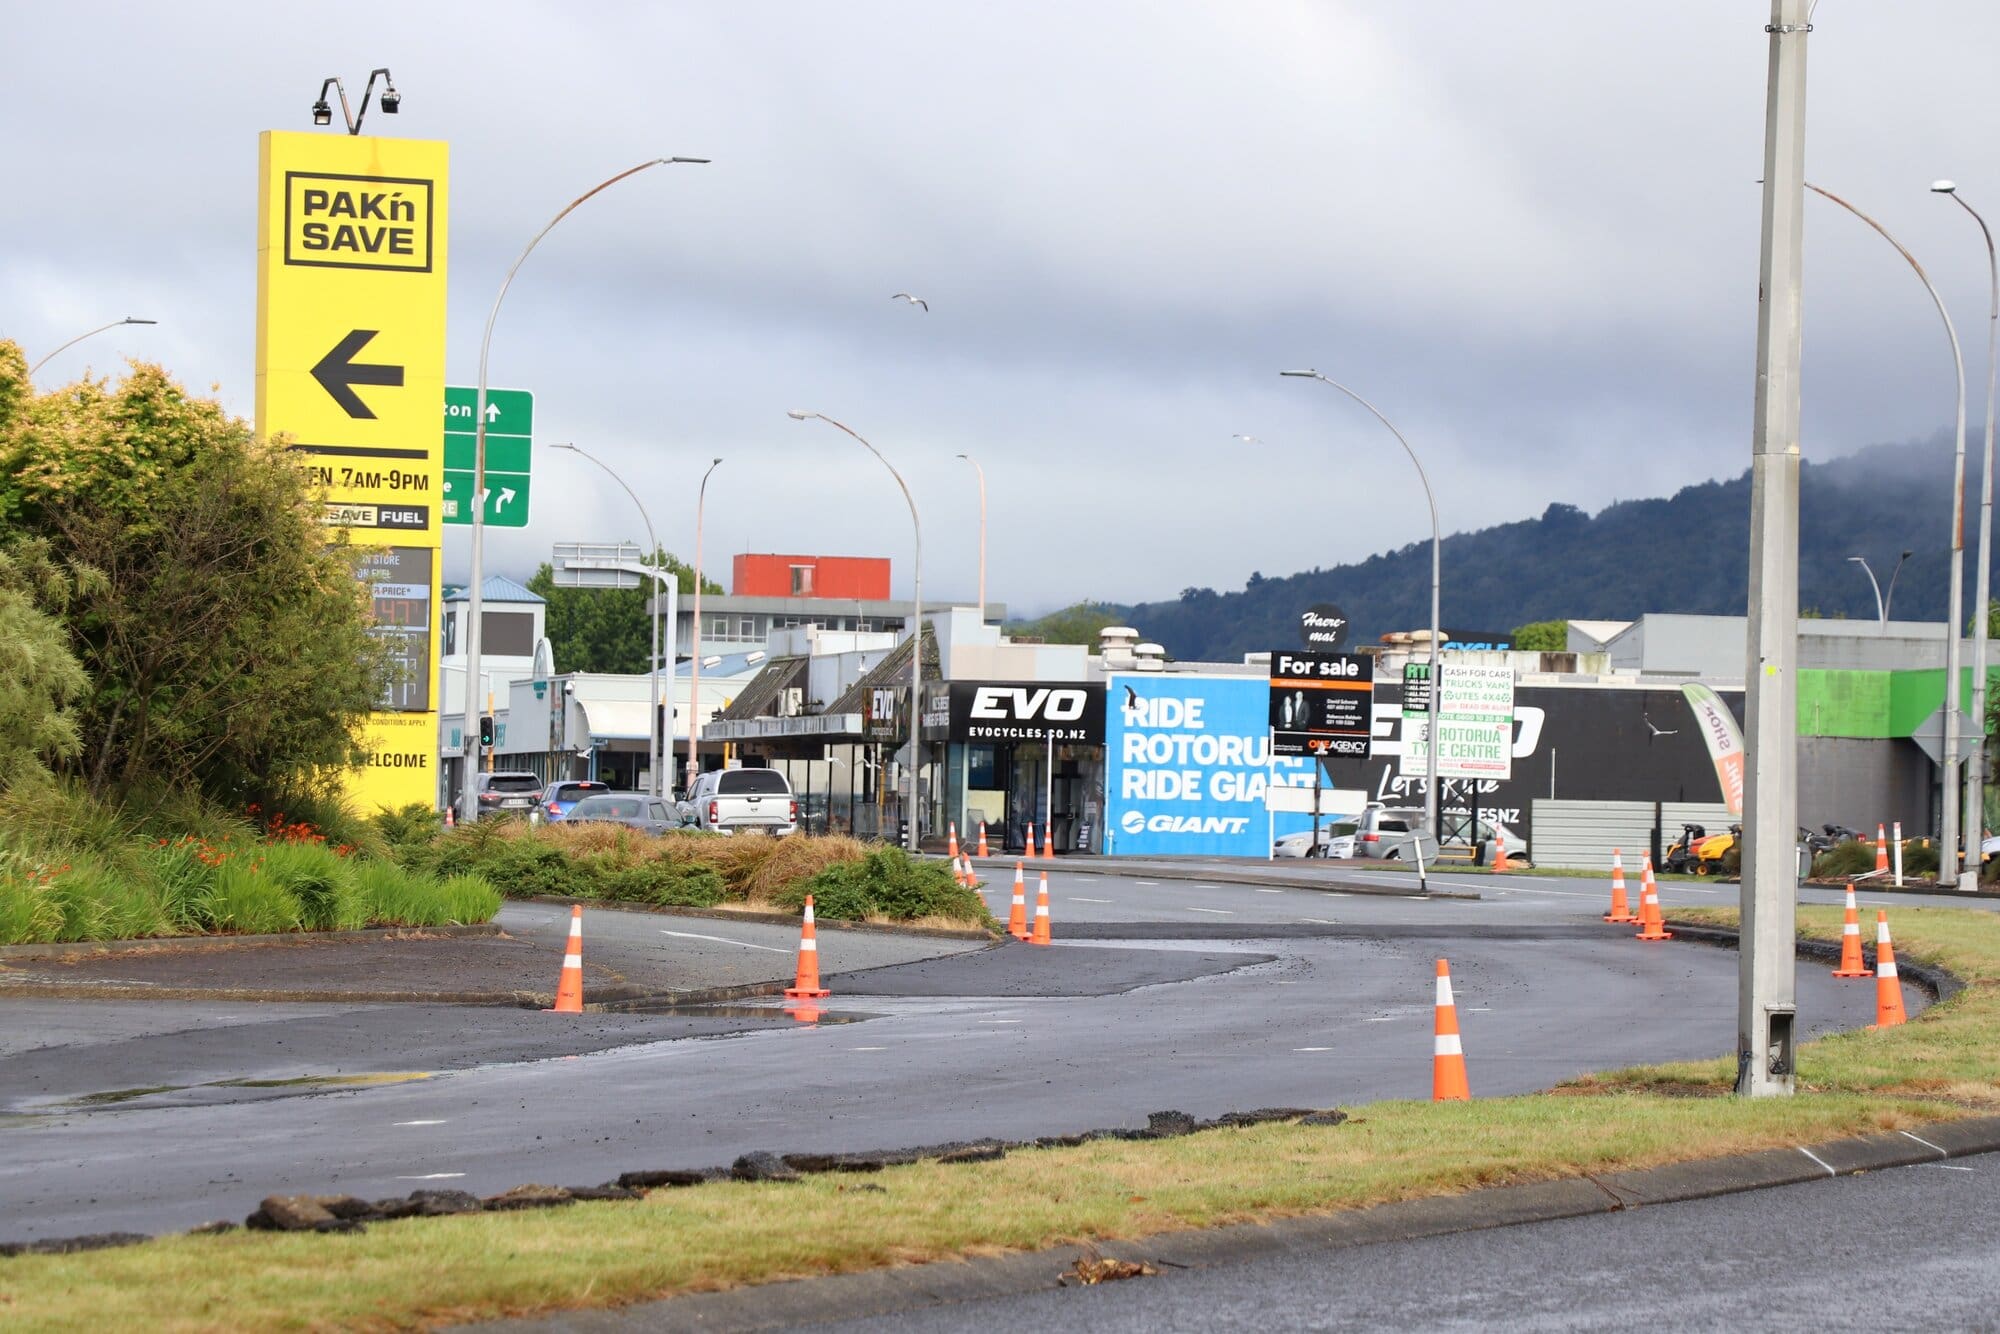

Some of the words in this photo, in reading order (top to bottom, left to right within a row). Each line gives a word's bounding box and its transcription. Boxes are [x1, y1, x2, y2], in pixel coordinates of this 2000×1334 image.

[302, 222, 414, 255] SAVE
[380, 511, 424, 524] FUEL
[373, 554, 401, 566] STORE
[1279, 656, 1315, 675] For
[1319, 657, 1359, 677] sale
[1444, 668, 1467, 676] CASH
[1469, 669, 1487, 677] FOR
[1488, 670, 1512, 679] CARS
[1444, 679, 1482, 689] TRUCKS
[1486, 680, 1510, 690] VANS
[871, 689, 894, 720] EVO
[969, 686, 1088, 721] EVO
[1455, 691, 1480, 701] UTES
[1122, 697, 1205, 729] RIDE
[968, 727, 1087, 739] EVOCYCLES.CO.NZ
[1439, 728, 1502, 743] ROTORUA
[1411, 741, 1446, 757] TYE
[1450, 743, 1502, 759] CENTRE
[366, 752, 428, 768] ELCOME
[1122, 769, 1203, 801] RIDE
[1147, 815, 1250, 834] GIANT
